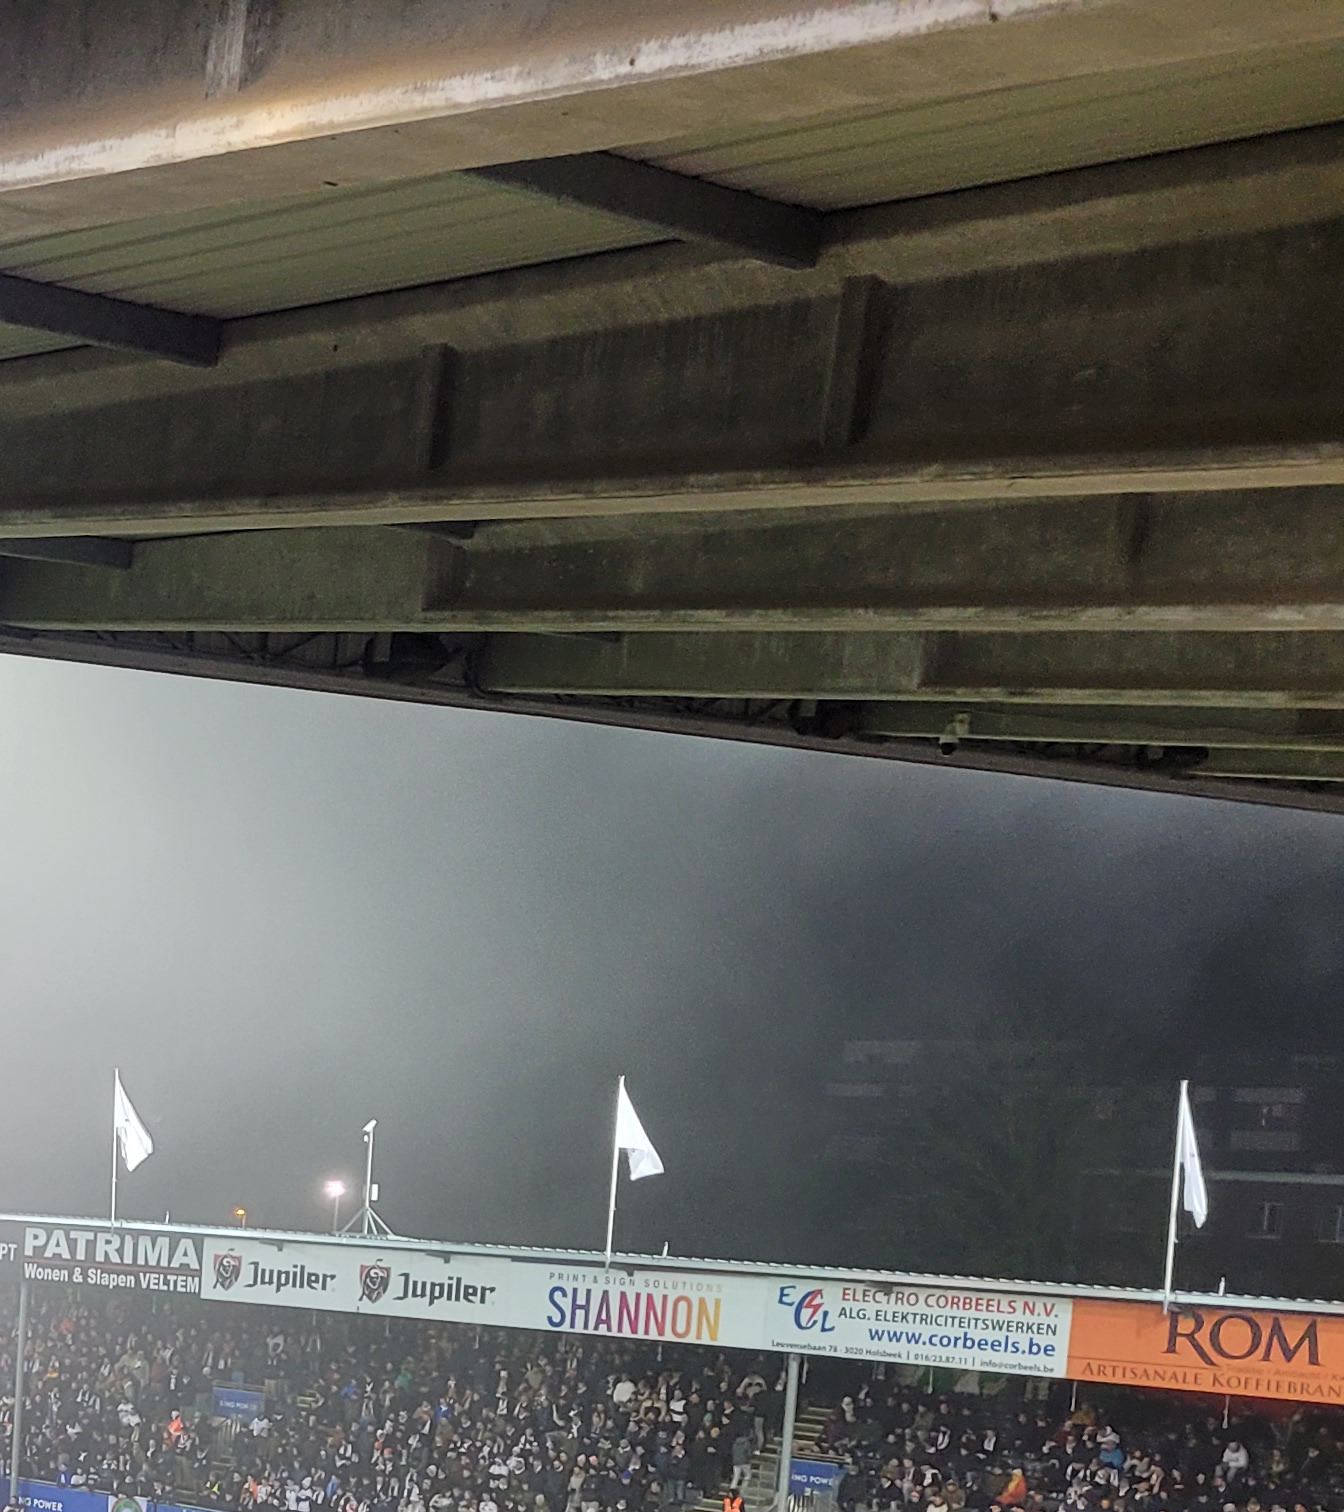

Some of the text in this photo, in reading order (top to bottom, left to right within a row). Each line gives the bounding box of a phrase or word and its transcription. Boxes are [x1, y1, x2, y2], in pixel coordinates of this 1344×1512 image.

[24, 1227, 200, 1270] PATRIMA
[24, 1262, 200, 1294] Wonen & Slapen VELTEM
[244, 1260, 336, 1293] Jupiler
[394, 1272, 496, 1307] Jupiler
[549, 1272, 724, 1293] PRINT & SIGN SOLUTIONS
[547, 1286, 721, 1341] SHANNON
[842, 1287, 1060, 1318] ELECTRO CORBEELS N.V.
[837, 1306, 1058, 1336] ALG. ELEKTRICITEITSWERKEN
[868, 1327, 1056, 1357] www.corbeels.be
[1161, 1309, 1325, 1367] ROM
[1082, 1361, 1202, 1386] ARTISANALE
[33, 1498, 64, 1512] POWER
